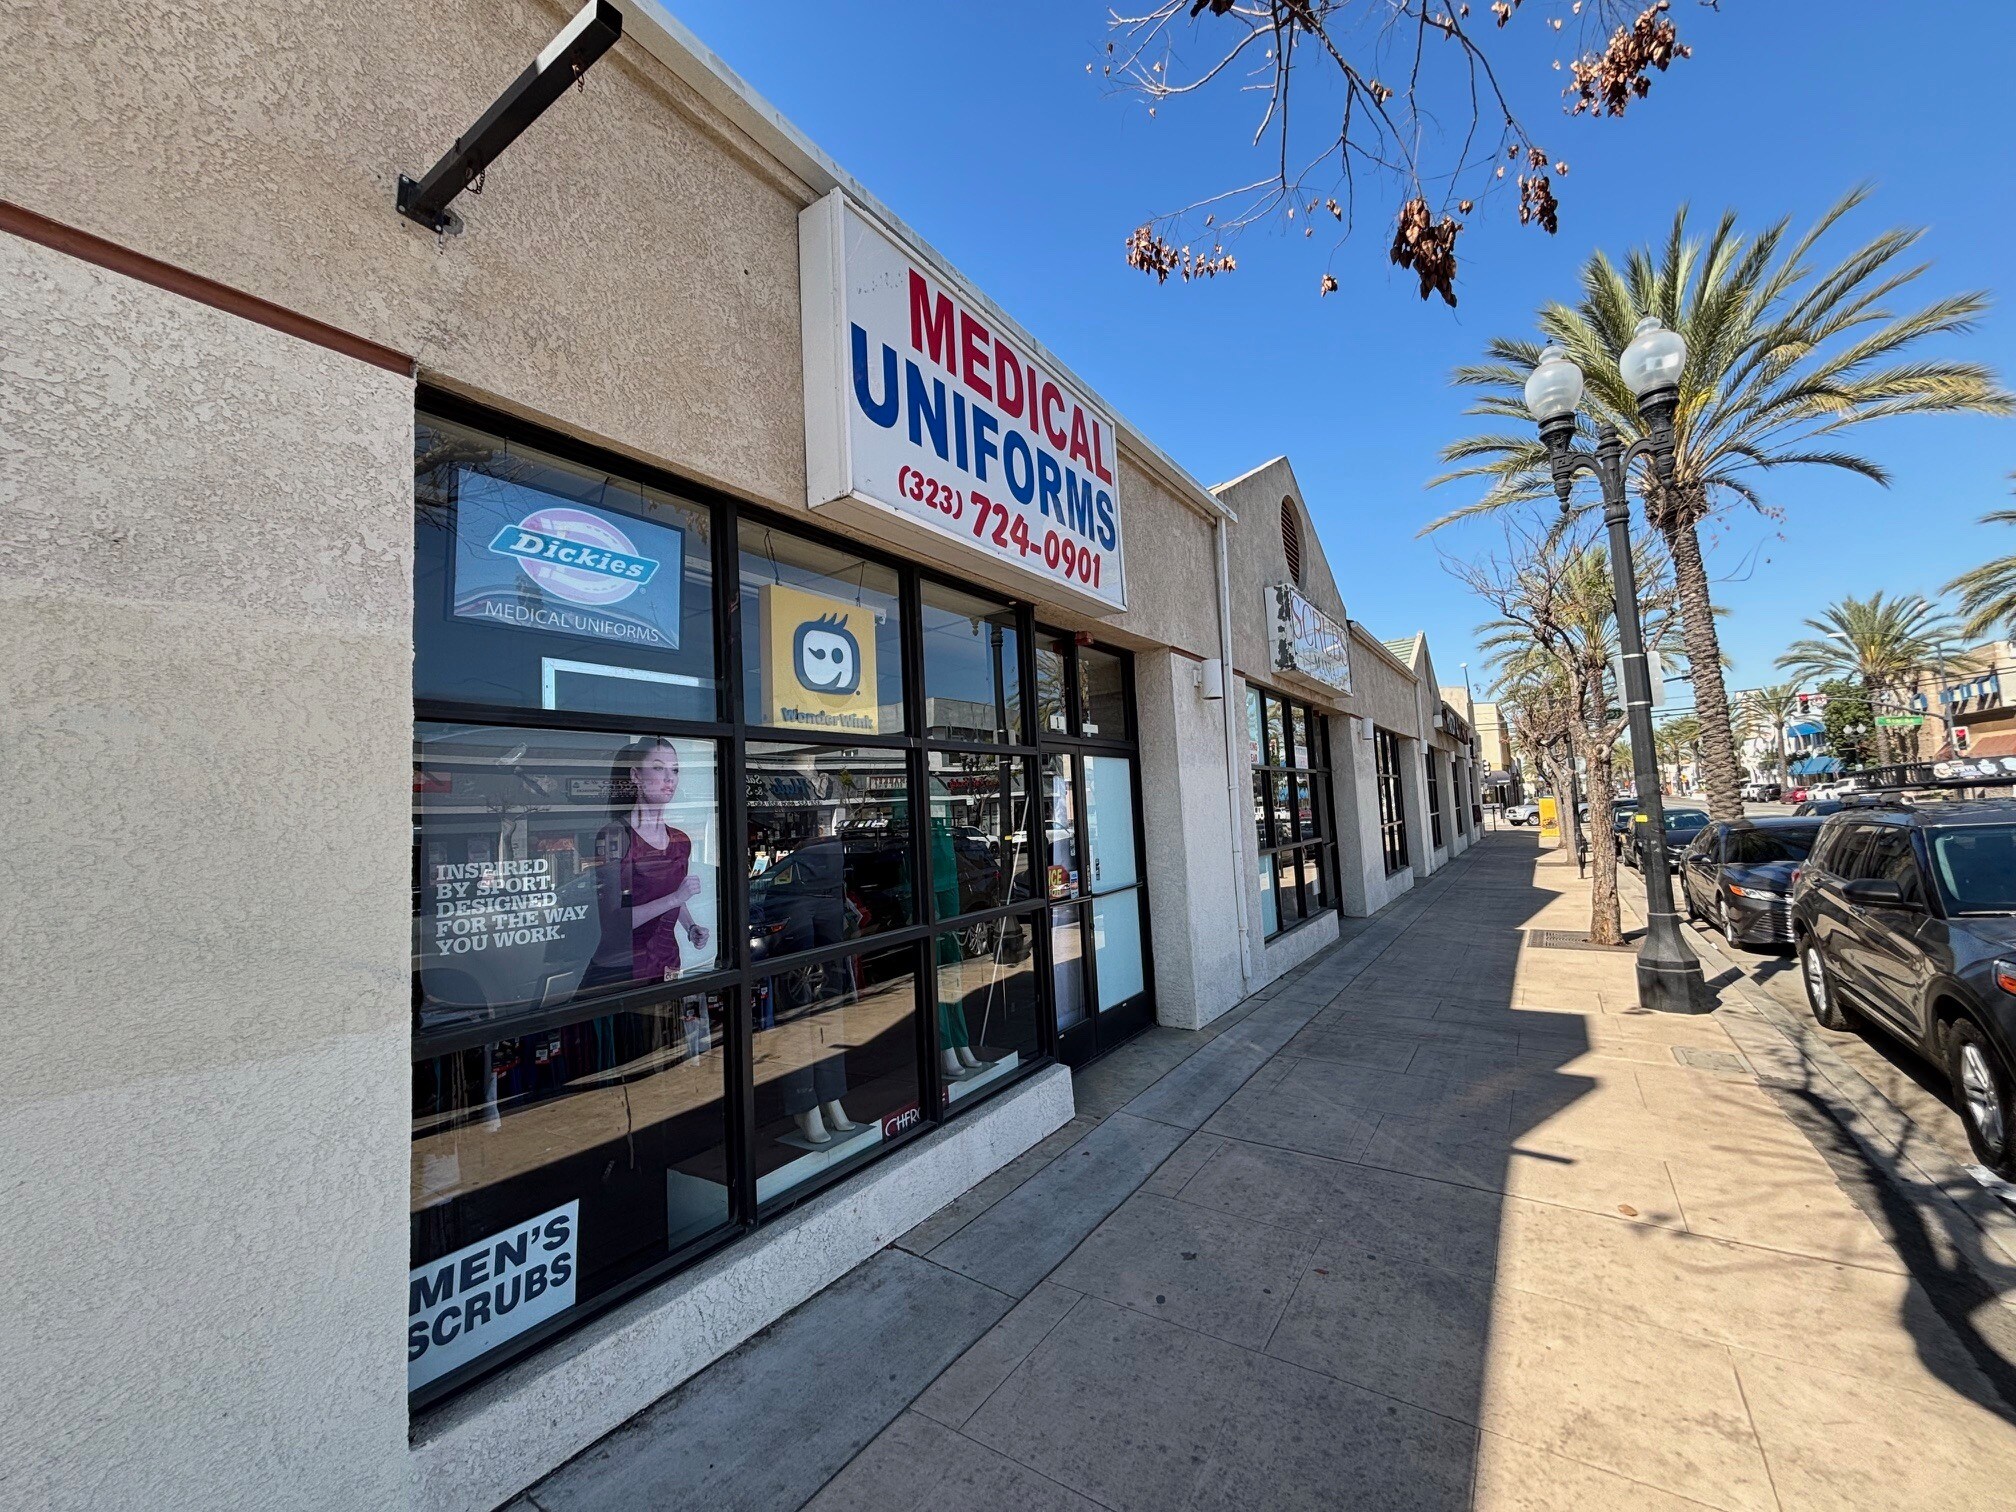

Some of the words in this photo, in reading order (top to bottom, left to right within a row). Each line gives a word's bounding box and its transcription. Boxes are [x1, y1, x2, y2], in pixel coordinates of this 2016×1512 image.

[908, 267, 1112, 486] MEDICAL
[851, 321, 1115, 552] UNIFORMS
[899, 465, 962, 520] (323)
[971, 491, 1100, 589] 724-0901
[509, 532, 645, 577] Dickies
[485, 600, 570, 628] MEDICAL
[575, 615, 659, 642] UNIFORMS
[781, 707, 873, 729] WonderWink
[436, 859, 548, 881] INSPIRED
[436, 881, 470, 900] BY
[476, 875, 556, 896] SPORT,
[436, 892, 558, 919] DESIGNED
[436, 917, 487, 938] FOR
[492, 911, 539, 930] THE
[544, 905, 589, 924] WAY
[436, 934, 488, 956] YOU
[493, 925, 566, 948] WORK.
[409, 1214, 570, 1317] MEN'S
[408, 1252, 572, 1362] SCRUBS
